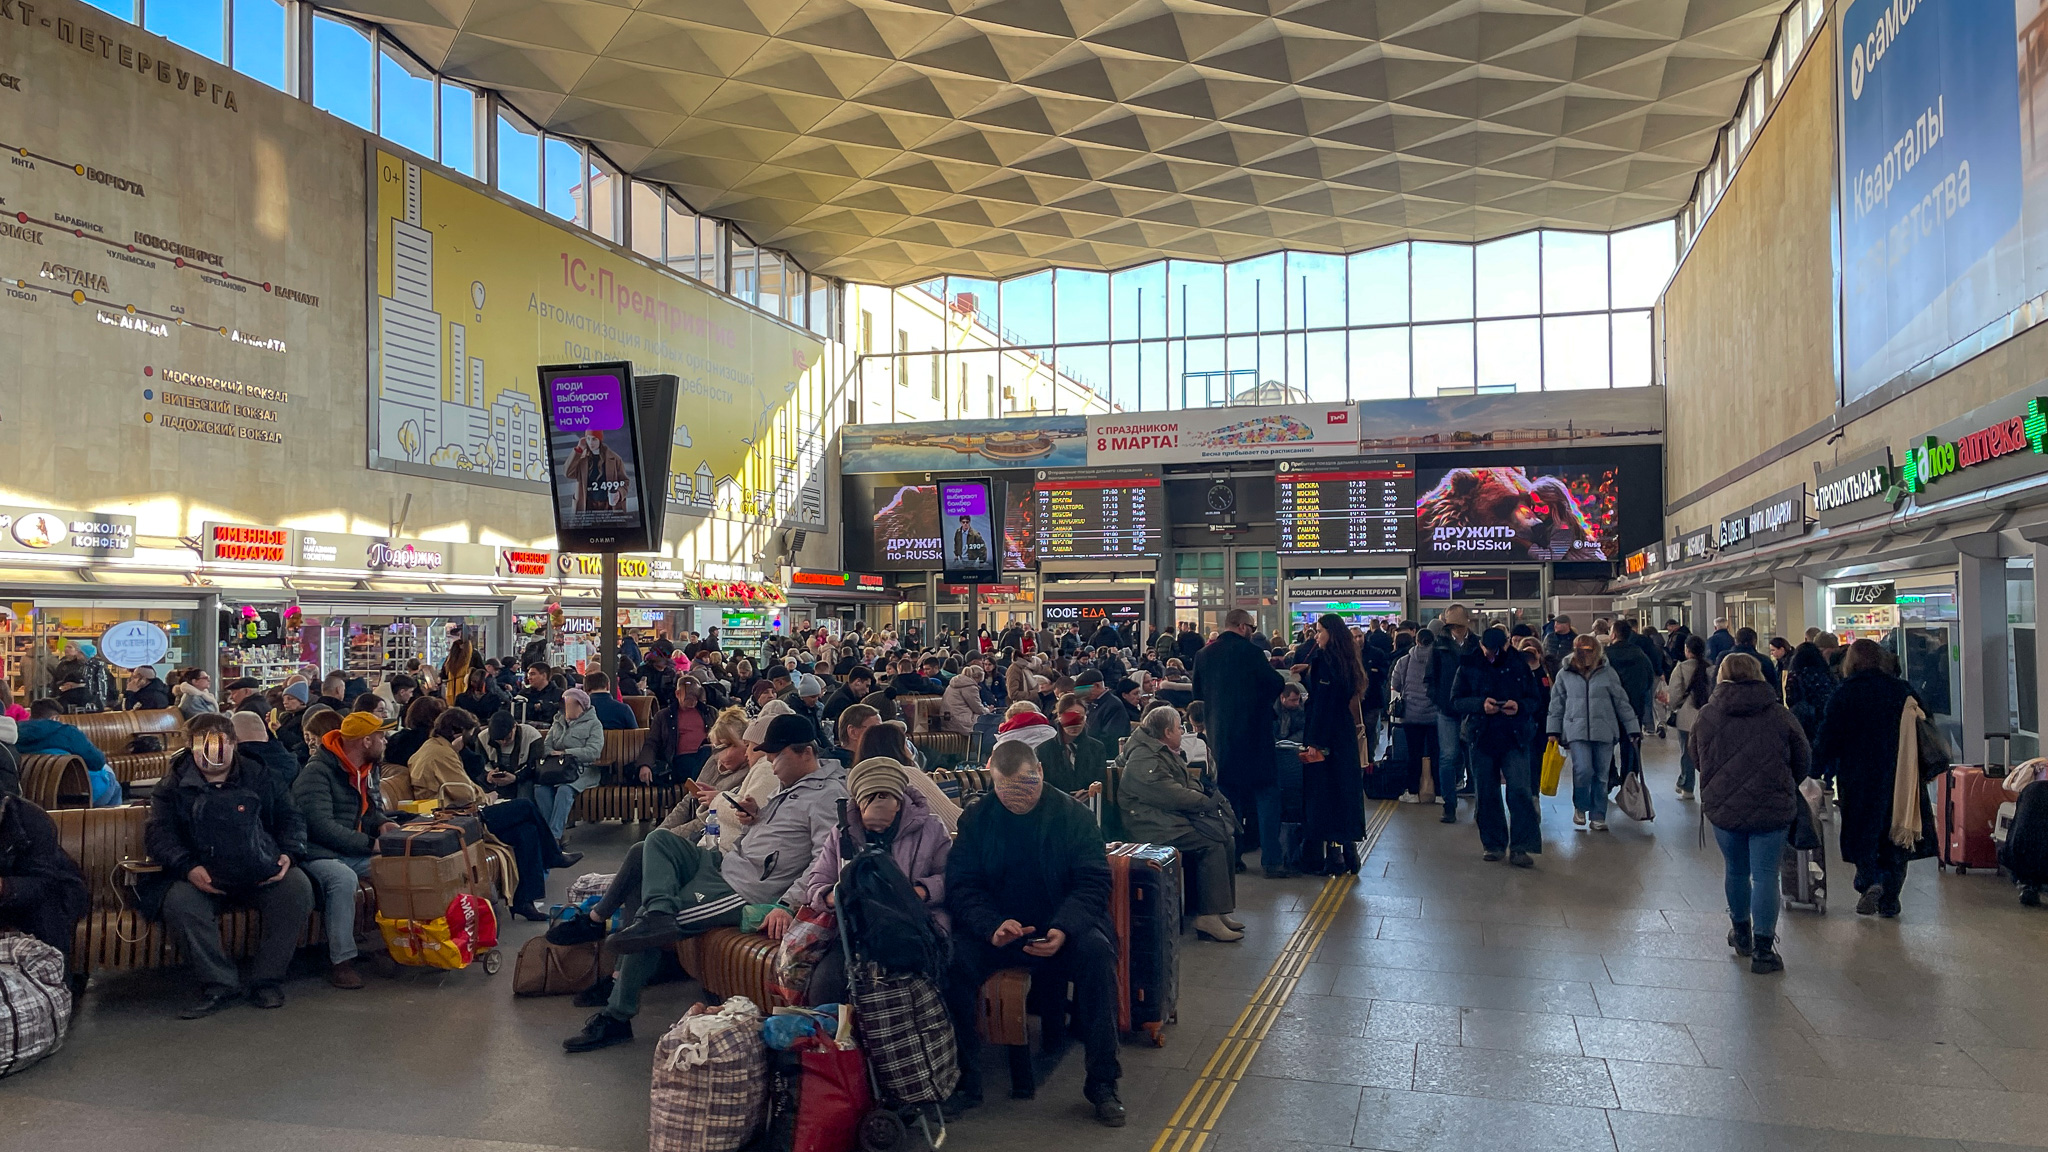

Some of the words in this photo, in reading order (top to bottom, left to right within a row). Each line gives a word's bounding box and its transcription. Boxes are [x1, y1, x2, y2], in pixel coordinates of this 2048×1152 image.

[11, 157, 35, 170] ИНТА
[1853, 94, 1944, 224] Кварталы
[86, 167, 145, 197] ВОРКУТА
[383, 166, 400, 184] 0+
[54, 212, 104, 234] БАРАБИНСК
[134, 231, 224, 268] НОВОСИБИРСК
[106, 249, 156, 270] ЧУЛЫМСКАЯ
[40, 261, 110, 293] АСТАНА
[200, 274, 247, 294] ЧЕРЕПАНОВО
[6, 288, 37, 302] ТОБОЛ
[274, 285, 320, 308] БАРНАУЛ
[528, 292, 641, 349] Автоматизация
[644, 338, 684, 365] любых
[687, 352, 756, 388] организаций
[564, 340, 591, 364] под
[162, 368, 243, 396] МОСКОВСКИЙ
[246, 385, 288, 404] ВОКЗАЛ
[555, 382, 583, 392] люди
[162, 392, 231, 415] ВИТЕБСКИЙ
[234, 407, 278, 423] ВОКЗАЛ
[557, 392, 609, 404] выбирают
[558, 405, 594, 415] пальто
[160, 414, 236, 437] ЛАДОЖСКИЙ
[238, 428, 282, 444] ВОКЗАЛ
[560, 417, 573, 426] на
[575, 415, 590, 426] wb
[1097, 427, 1104, 435] С
[1106, 423, 1178, 434] ПРАЗДНИКОМ
[1097, 438, 1107, 451] 8
[1111, 435, 1178, 450] МАРТА!
[1918, 437, 1956, 485] алоэ
[1958, 415, 2027, 468] аптека
[1819, 473, 1862, 511] ПРОДУКТЫ
[1766, 499, 1792, 531] ПОДАРКИ
[70, 521, 132, 537] ШОКОЛАД
[214, 526, 287, 545] ИМЕННЫЕ
[1433, 526, 1516, 540] ДРУЖИТЬ
[71, 535, 129, 549] КОНФЕТЫ
[1433, 540, 1512, 551] по-RUSSки
[215, 543, 285, 561] ПОДАРКИ
[367, 542, 442, 569] Подружка
[516, 563, 546, 575] ЛОЖКИ
[1291, 589, 1332, 597] КОНДИТЕРЫ
[1333, 588, 1397, 596] САНКТ-ПЕТЕРБУРГА
[561, 618, 595, 632] ЛИНЫ
